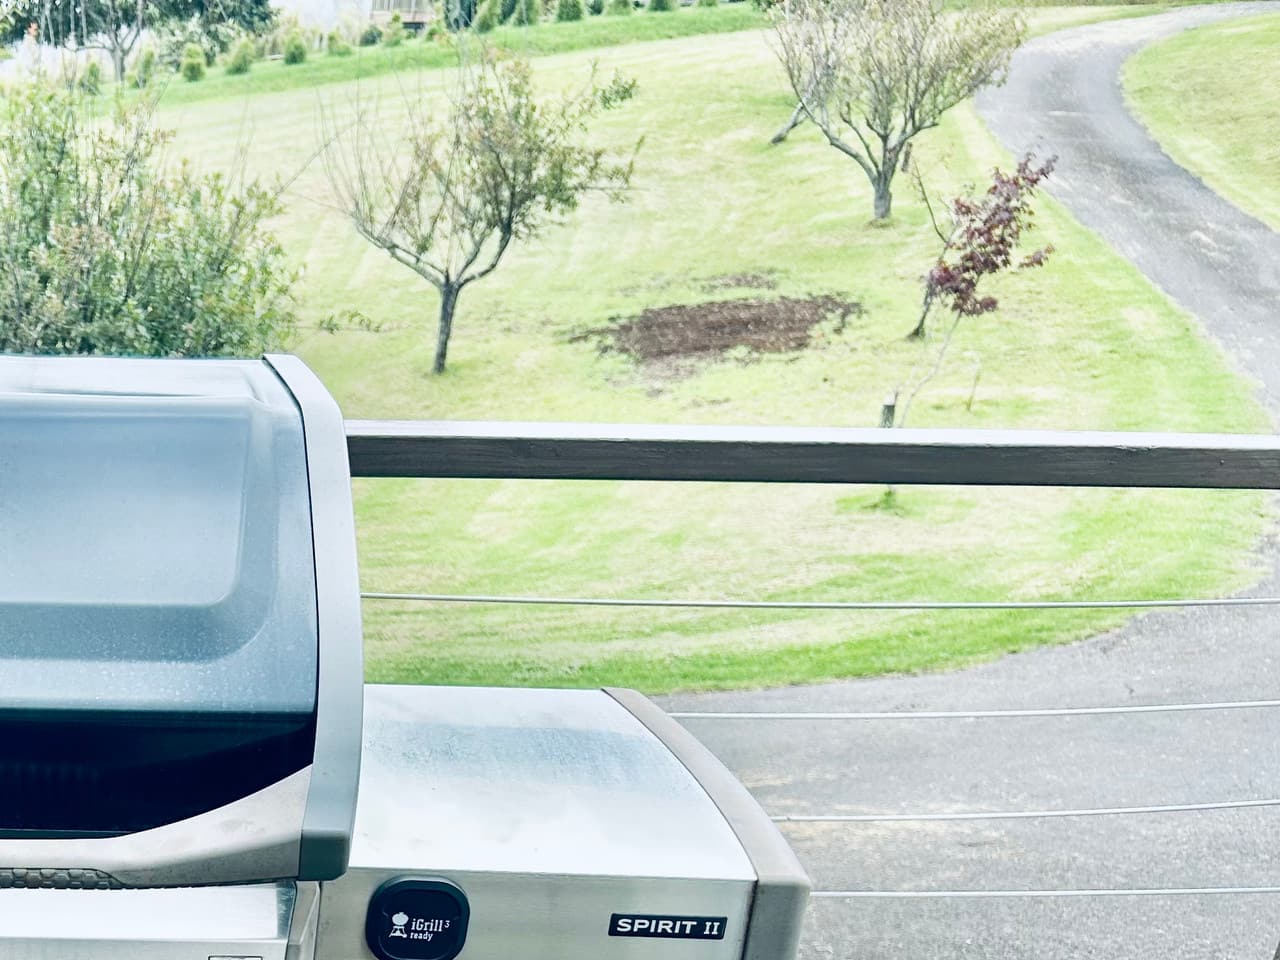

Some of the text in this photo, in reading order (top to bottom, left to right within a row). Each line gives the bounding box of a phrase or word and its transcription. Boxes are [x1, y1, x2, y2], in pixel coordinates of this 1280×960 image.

[616, 918, 720, 935] SPIRIT II
[410, 931, 434, 942] ready
